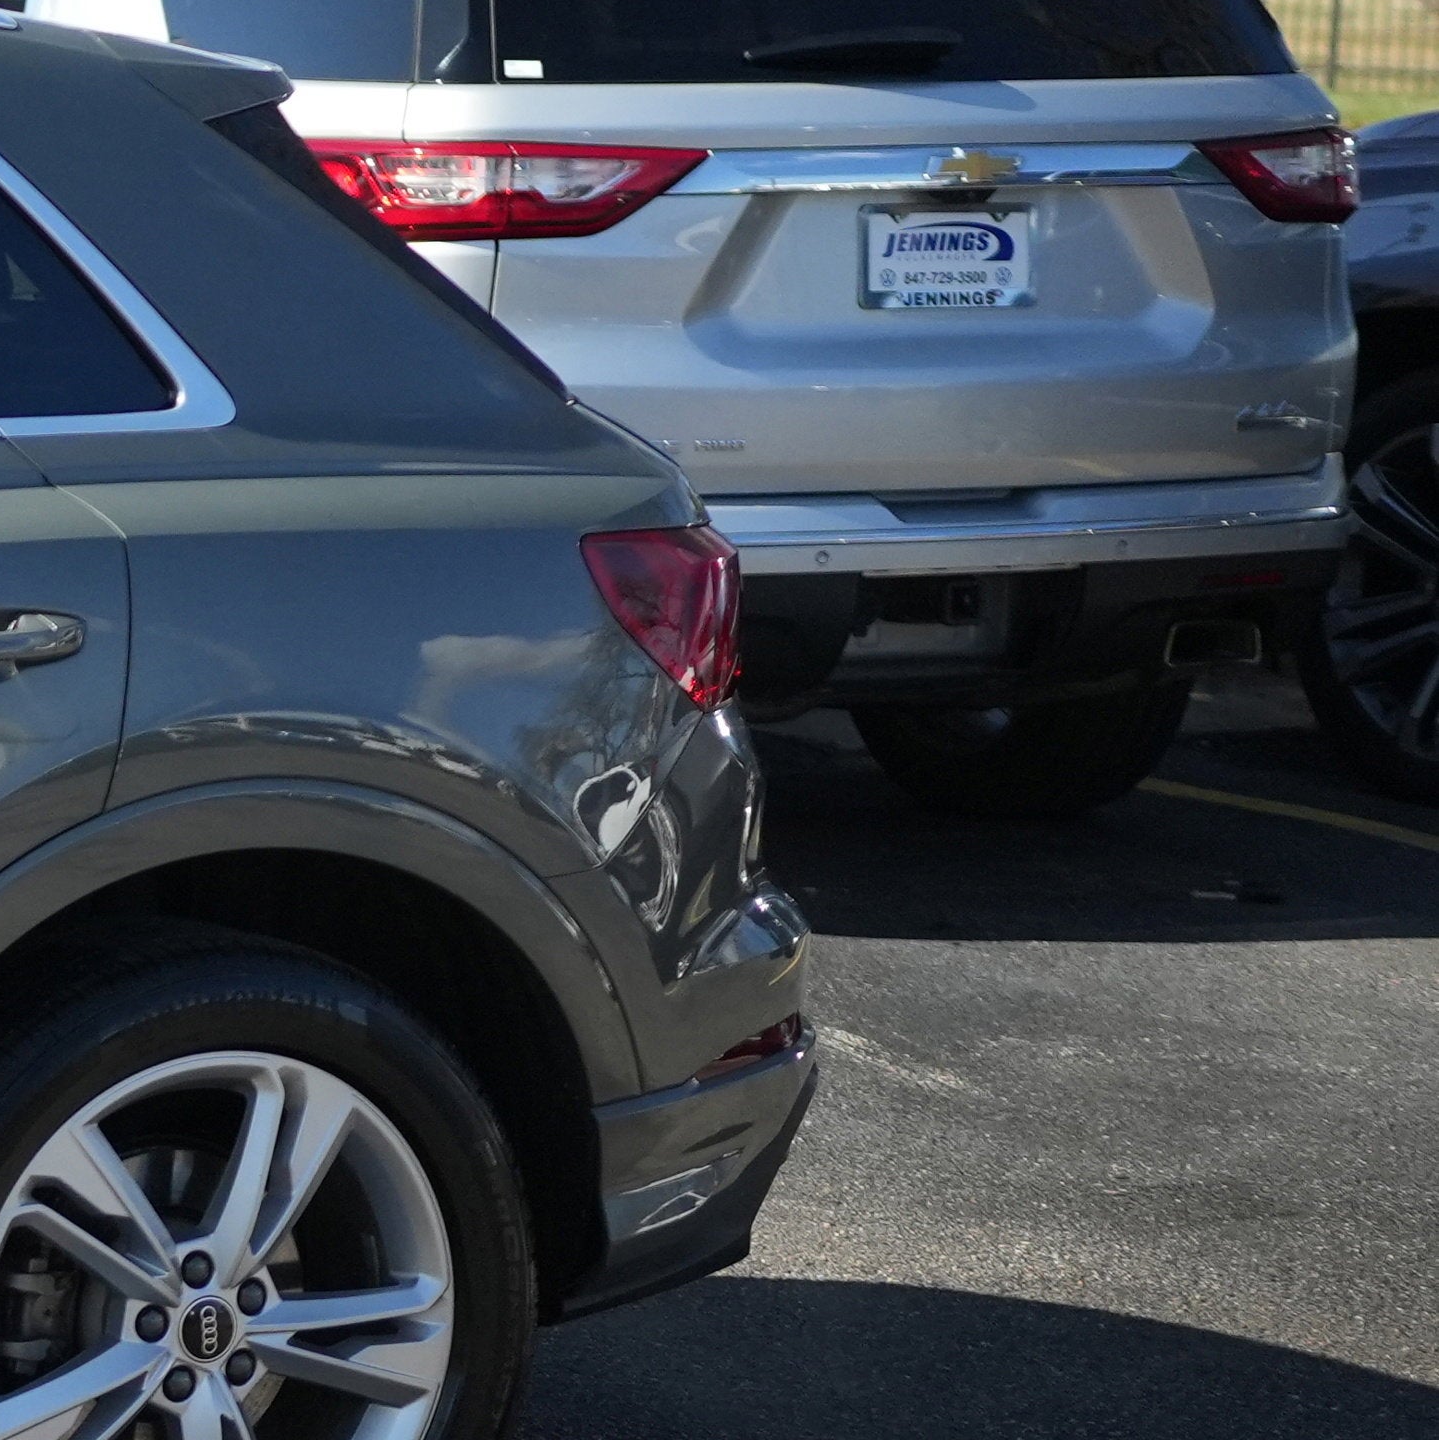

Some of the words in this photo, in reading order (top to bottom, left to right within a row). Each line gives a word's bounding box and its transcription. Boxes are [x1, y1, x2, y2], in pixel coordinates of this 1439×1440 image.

[882, 231, 990, 258] JENNINGS
[903, 270, 988, 285] 847-729-3500
[902, 290, 997, 306] JENNINGS
